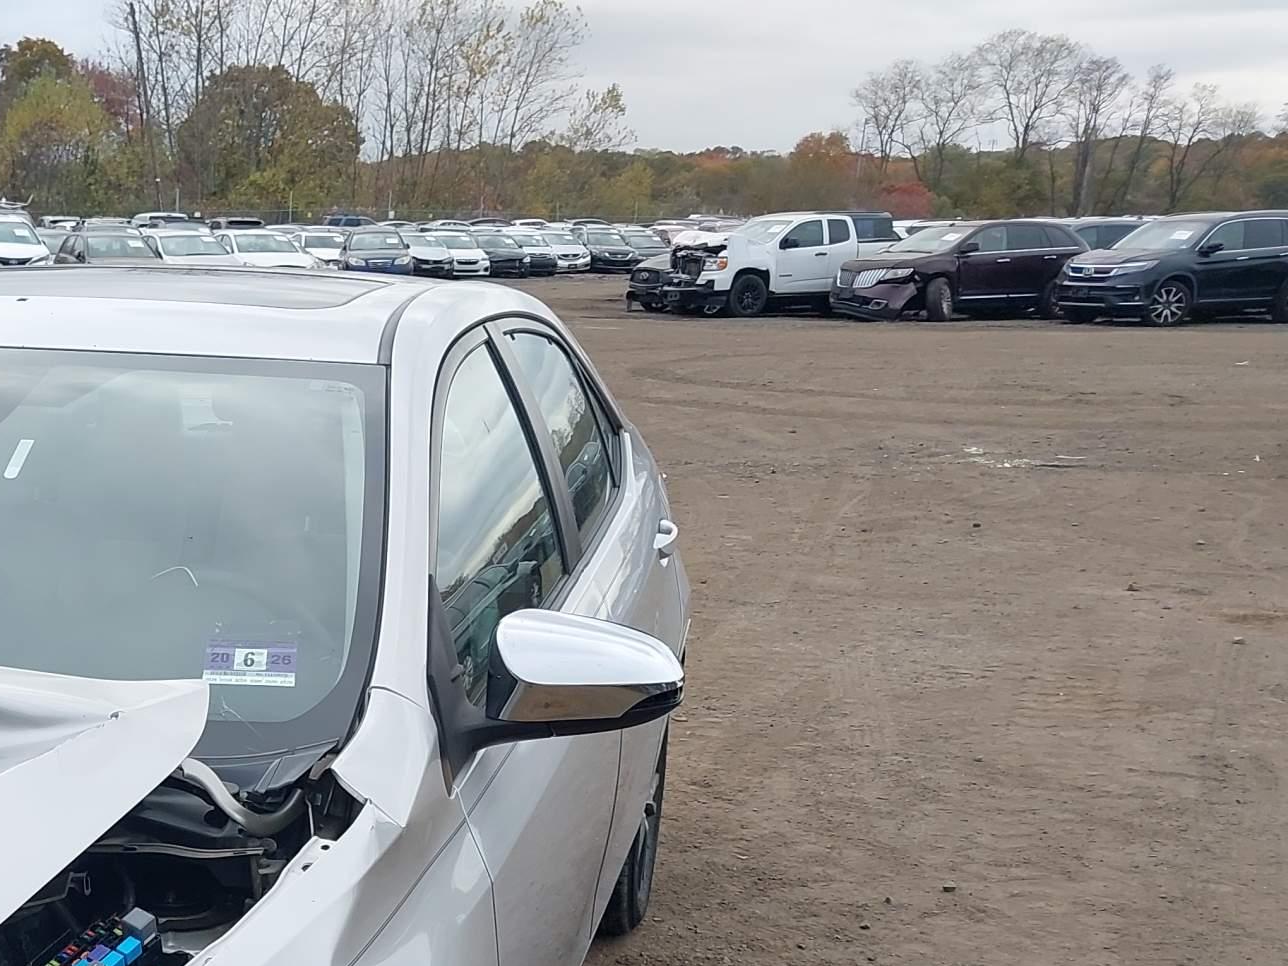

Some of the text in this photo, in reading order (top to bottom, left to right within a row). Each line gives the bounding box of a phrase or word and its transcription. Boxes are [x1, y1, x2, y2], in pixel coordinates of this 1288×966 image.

[210, 651, 292, 668] 20 6 26
